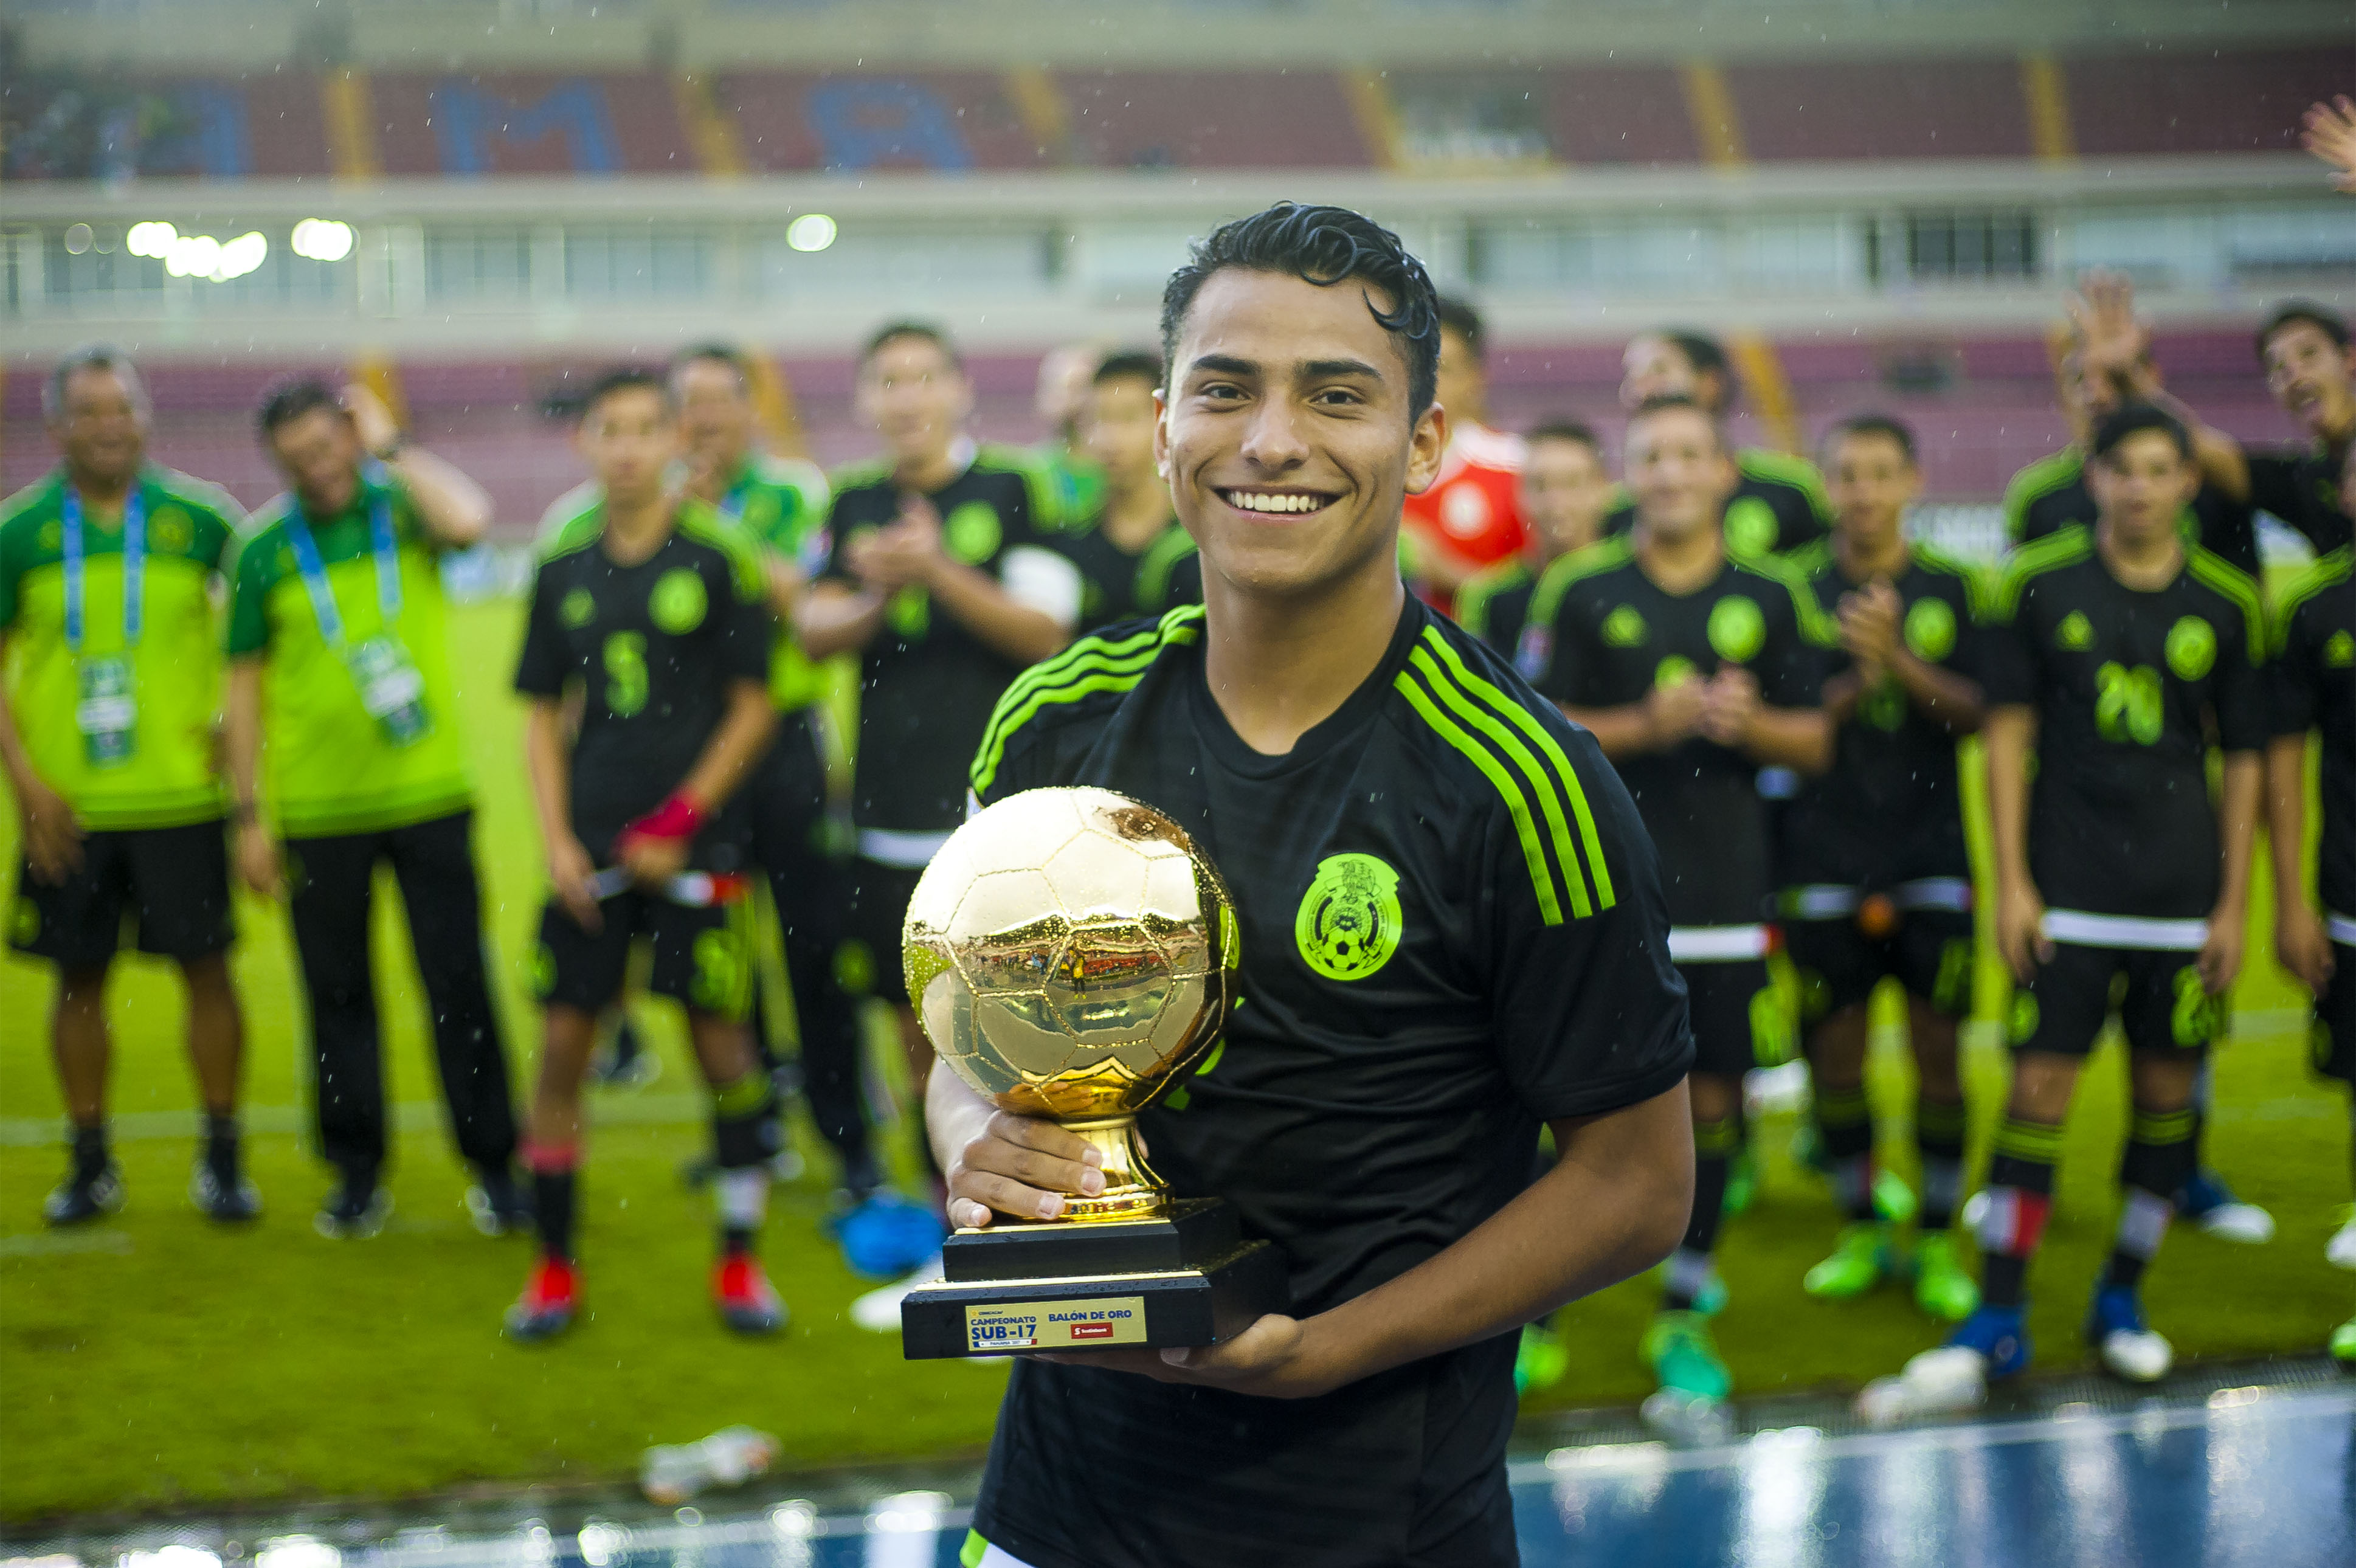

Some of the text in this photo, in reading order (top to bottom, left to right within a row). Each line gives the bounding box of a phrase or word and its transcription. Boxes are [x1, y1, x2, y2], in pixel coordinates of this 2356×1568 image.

[970, 1316, 1037, 1325] CAMPEONATO
[1048, 1310, 1132, 1322] BALÓN DE ORO
[972, 1324, 1037, 1340] SUB-17
